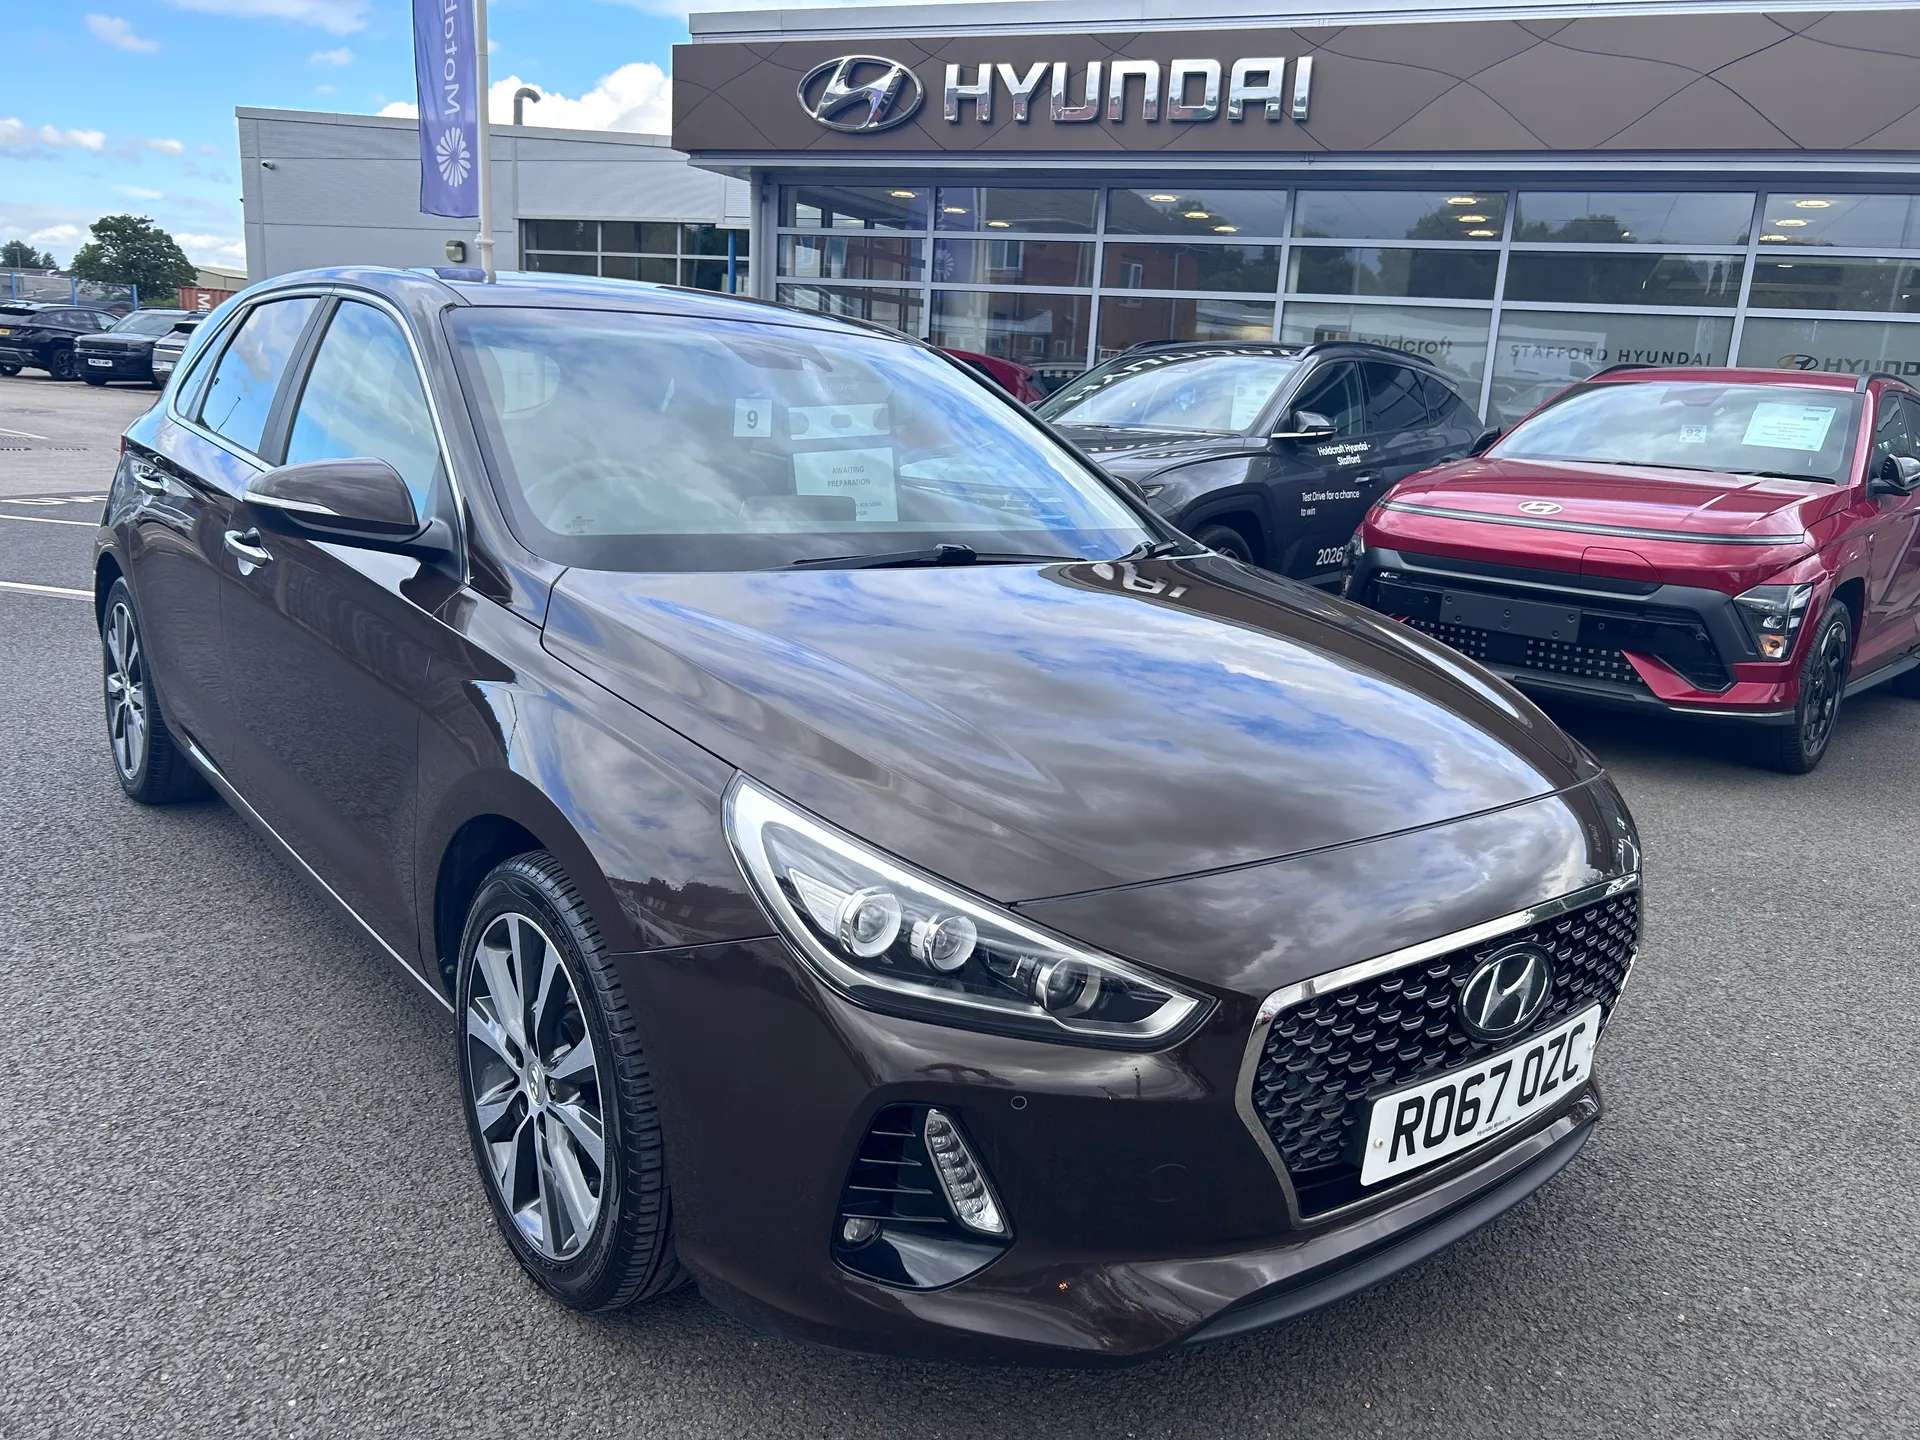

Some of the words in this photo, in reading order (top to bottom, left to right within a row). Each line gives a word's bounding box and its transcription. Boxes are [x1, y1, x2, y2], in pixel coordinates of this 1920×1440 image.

[943, 56, 1314, 123] HYUNDAI
[1509, 344, 1608, 361] STAFFORD
[1617, 349, 1712, 366] HYUNDAI
[746, 409, 759, 429] 9
[1336, 454, 1361, 466] Stafford
[1301, 492, 1313, 502] Test
[1312, 491, 1326, 501] Drive
[1326, 490, 1335, 500] for
[1339, 490, 1360, 499] chance
[1315, 546, 1344, 566] 2026
[1388, 1059, 1513, 1163] RO67
[1517, 1021, 1586, 1108] OZC
